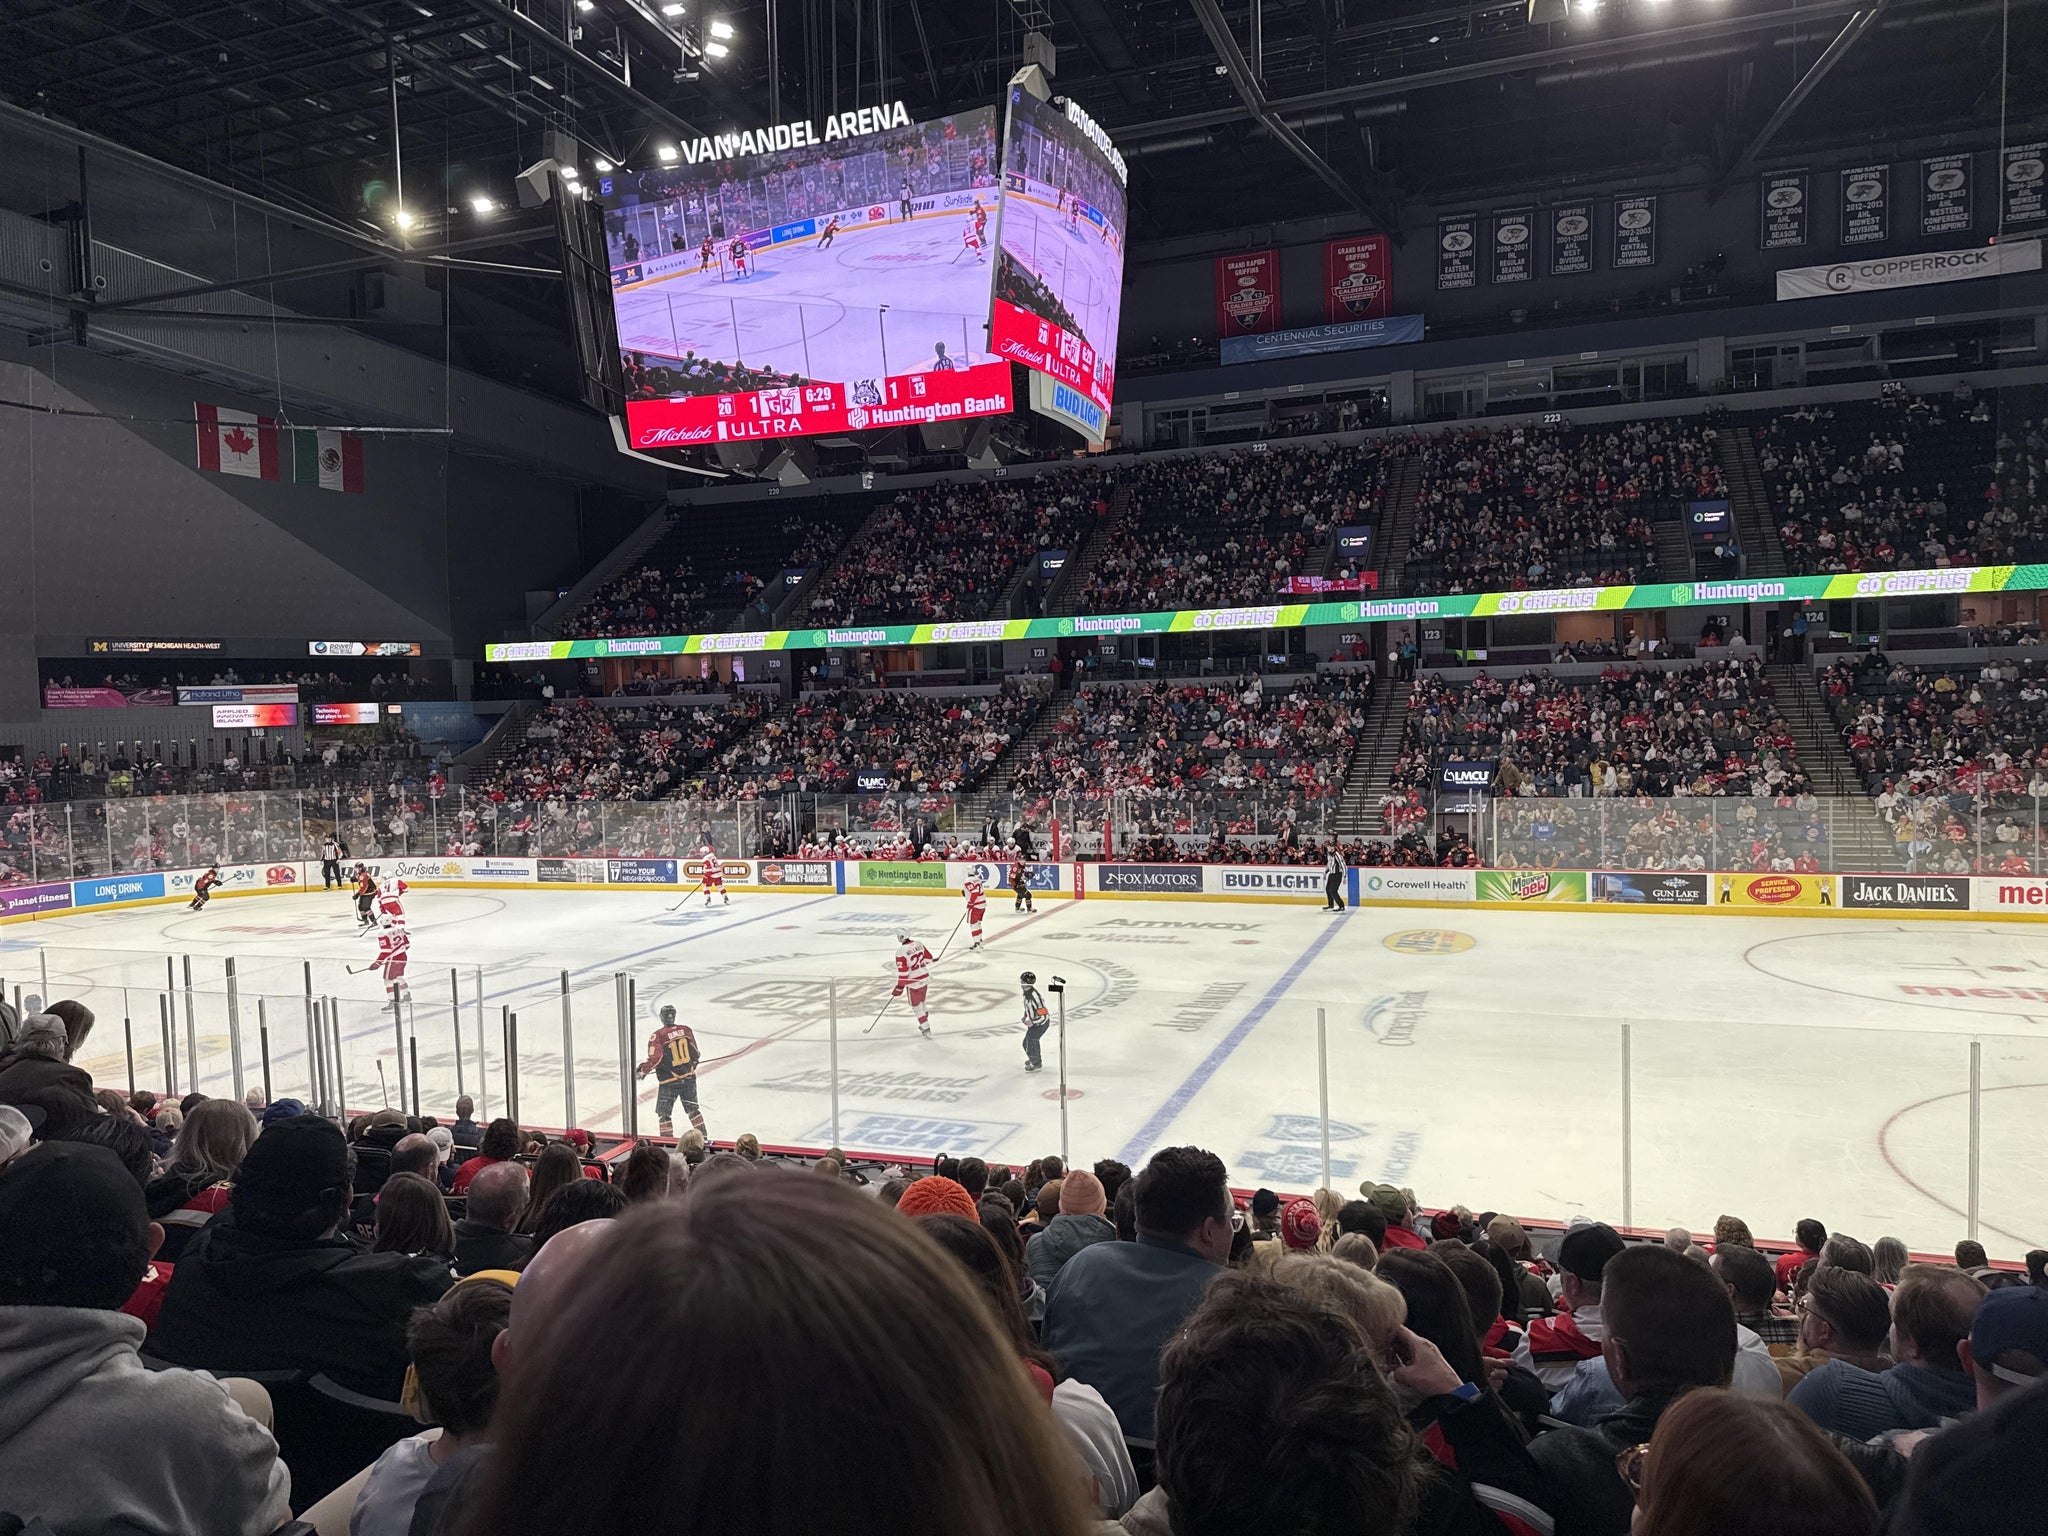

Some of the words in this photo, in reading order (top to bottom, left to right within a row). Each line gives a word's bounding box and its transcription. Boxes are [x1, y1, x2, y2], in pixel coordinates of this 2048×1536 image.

[1067, 98, 1090, 137] VAN
[681, 133, 731, 164] VAN
[739, 120, 821, 156] ANDEL
[825, 100, 911, 142] ARENA
[1849, 171, 1881, 182] GRIFFINS
[1770, 178, 1800, 188] GRIFFINS
[943, 194, 974, 207] Surfside
[1621, 200, 1649, 210] GRIFFINS
[1846, 200, 1884, 212] 2012-2013
[1857, 210, 1871, 218] AHL
[1929, 205, 1965, 217] WESTERN
[1848, 216, 1881, 227] MIDWEST
[1923, 212, 1969, 225] CONFERENCE
[1849, 224, 1880, 235] DIVISION
[1926, 221, 1968, 233] CHAMPIONS
[1844, 231, 1884, 243] CHAMPIONS
[1338, 246, 1357, 255] GRAND
[1357, 243, 1377, 253] RAPIDS
[1620, 242, 1648, 251] CENTRAL
[1345, 252, 1370, 261] GRIFFINS
[1562, 249, 1581, 257] WEST
[1621, 249, 1648, 258] DIVISION
[1228, 261, 1246, 270] GRAND
[1246, 258, 1266, 267] RAPIDS
[1617, 256, 1651, 265] CHAMPIONS
[1860, 250, 1988, 278] COPPERROCK
[1235, 266, 1259, 276] GRIFFINS
[1501, 265, 1523, 274] SEASON
[1555, 262, 1589, 272] CHAMPIONS
[1496, 272, 1528, 281] CHAMPIONS
[1835, 273, 1846, 283] R
[1869, 266, 1980, 285] CONSTRUCTION
[1442, 278, 1472, 288] CHAMPIONS
[1339, 286, 1363, 294] CALDER
[1256, 329, 1321, 345] CENTENNIAL
[1324, 320, 1385, 336] SECURITIES
[1000, 338, 1045, 364] Michelob
[1052, 358, 1081, 386] ULTRA
[805, 386, 832, 403] 6:29
[889, 382, 898, 399] 1
[913, 381, 926, 396] 13
[718, 402, 732, 415] 20
[749, 396, 758, 414] 1
[872, 402, 962, 424] Huntington
[964, 394, 1006, 414] Bank
[1055, 385, 1080, 416] BUD
[1080, 399, 1102, 430] LIGHT
[1544, 414, 1561, 423] 223
[640, 424, 714, 445] Michelob
[731, 417, 803, 437] ULTRA
[1253, 443, 1267, 452] 222
[995, 468, 1007, 476] 221
[1857, 578, 1883, 593] GO
[1884, 573, 1972, 591] GRIFFINS!
[1694, 581, 1785, 603] Huntington
[1499, 598, 1521, 611] GO
[1523, 592, 1598, 611] GRIFFINS!
[1359, 599, 1439, 621] Huntington
[1193, 614, 1212, 628] GO
[1214, 609, 1278, 627] GRIFFINS!
[1805, 611, 1825, 622] 124
[1074, 616, 1141, 634] Huntington
[827, 629, 886, 645] Huntington
[932, 627, 949, 640] GO
[950, 625, 1005, 639] GRIFFINS!
[1341, 634, 1356, 643] 122
[1424, 630, 1441, 640] 123
[93, 642, 108, 652] M
[183, 642, 221, 650] HEALTH-WEST
[607, 638, 662, 655] Huntington
[700, 637, 714, 650] GO
[715, 635, 766, 650] GRIFFINS!
[492, 648, 506, 659] GO
[507, 646, 553, 658] GRIFFINS!
[1033, 649, 1045, 657] 121
[1101, 646, 1115, 654] 122
[768, 659, 781, 668] 120
[829, 657, 840, 666] 121
[587, 666, 598, 675] 120
[191, 690, 221, 698] Holland
[222, 689, 242, 698] Litho
[251, 728, 265, 736] 118
[1454, 770, 1489, 781] LMCU
[395, 861, 441, 877] Surfside
[610, 868, 620, 881] 17
[638, 867, 656, 875] YOUR
[784, 863, 810, 874] GRAND
[811, 863, 828, 874] RAPIDS
[784, 873, 828, 884] HARLEY-DAVIDSON
[878, 870, 928, 882] Huntington
[929, 870, 944, 880] Bank
[1118, 874, 1142, 885] FOX
[1144, 873, 1198, 886] MOTORS
[1225, 874, 1263, 888] BUD
[1266, 875, 1321, 889] LIGHT
[1386, 880, 1430, 890] Corewell
[1433, 881, 1466, 890] Health
[1760, 879, 1789, 887] SERVICE
[95, 885, 117, 897] LONG
[118, 882, 144, 894] DRINK
[1652, 889, 1675, 898] GUN
[1675, 889, 1699, 899] LAKE
[1754, 885, 1796, 894] PROFESSOR
[1853, 882, 1893, 902] JACK
[1897, 883, 1956, 902] DANIEL'S
[9, 894, 38, 909] planet
[39, 892, 70, 903] fitness
[1096, 918, 1265, 931] Amway
[910, 951, 928, 972] 22
[667, 1037, 691, 1067] 10
[857, 1115, 979, 1136] BUD
